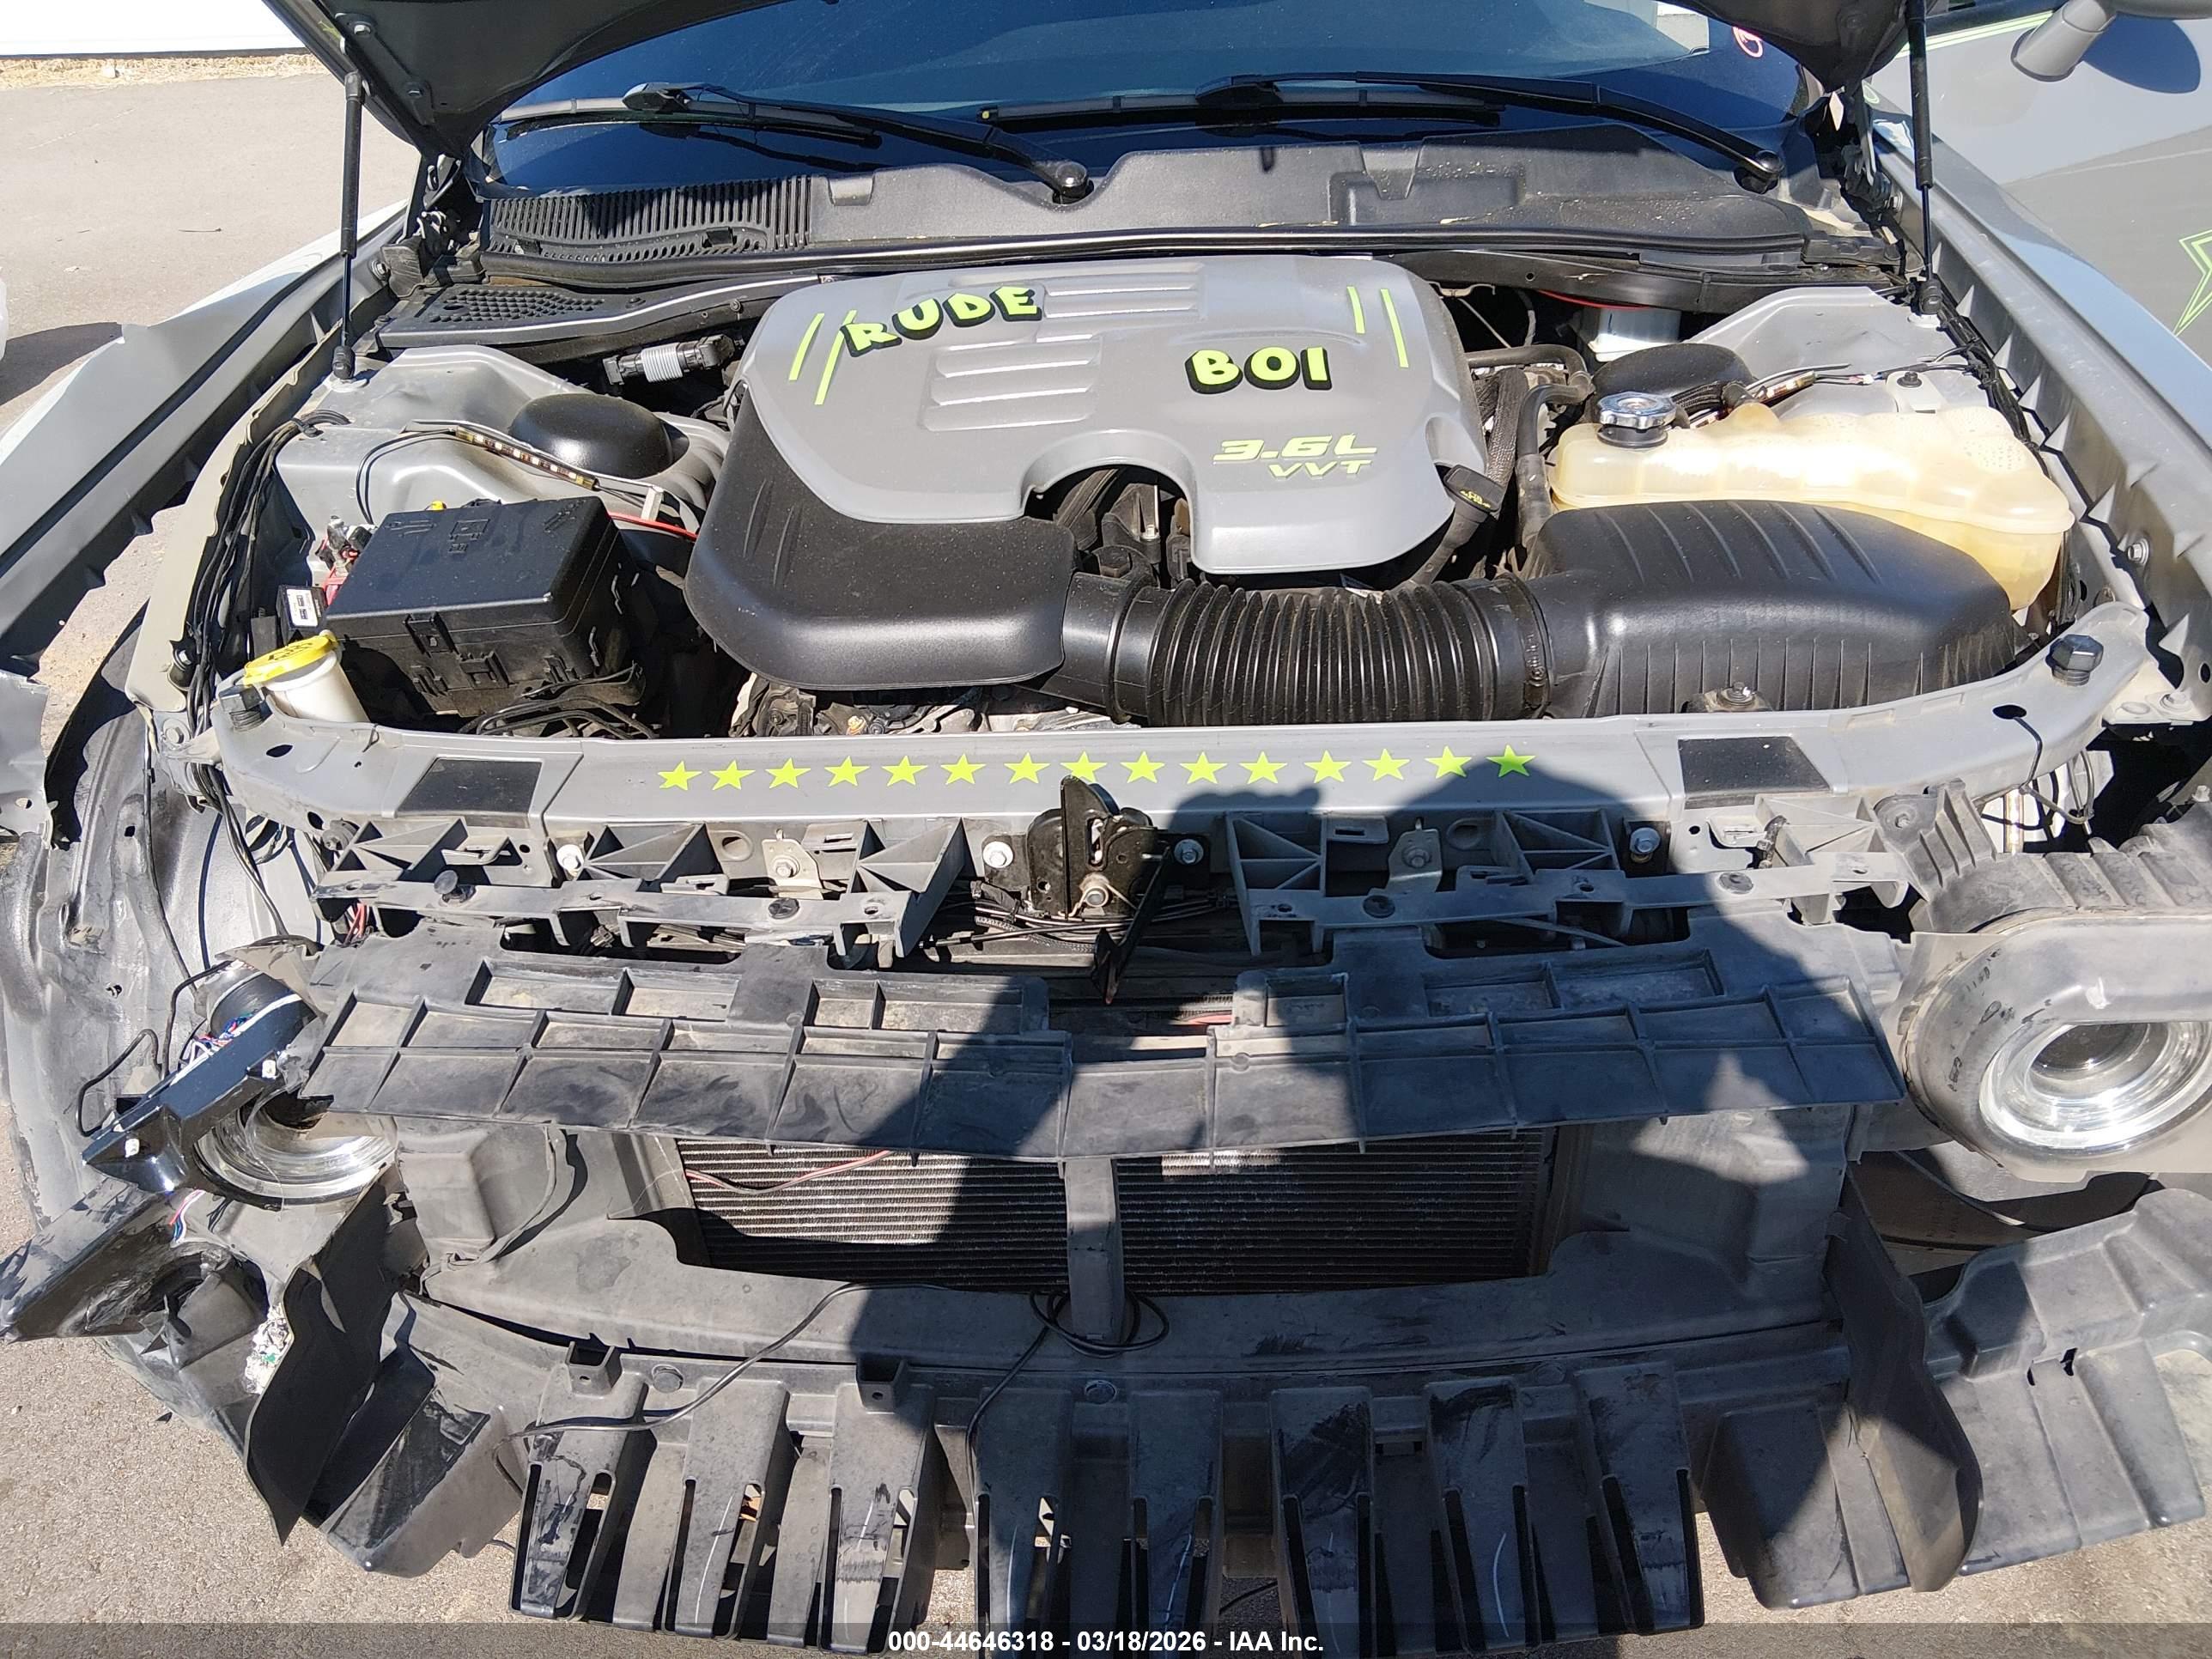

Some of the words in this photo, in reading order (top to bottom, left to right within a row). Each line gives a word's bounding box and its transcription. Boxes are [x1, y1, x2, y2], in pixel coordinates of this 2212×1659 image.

[840, 286, 1042, 358] RUDE
[1184, 345, 1333, 395] BOI
[1212, 433, 1378, 465] 3.6L
[1268, 459, 1373, 479] VVT
